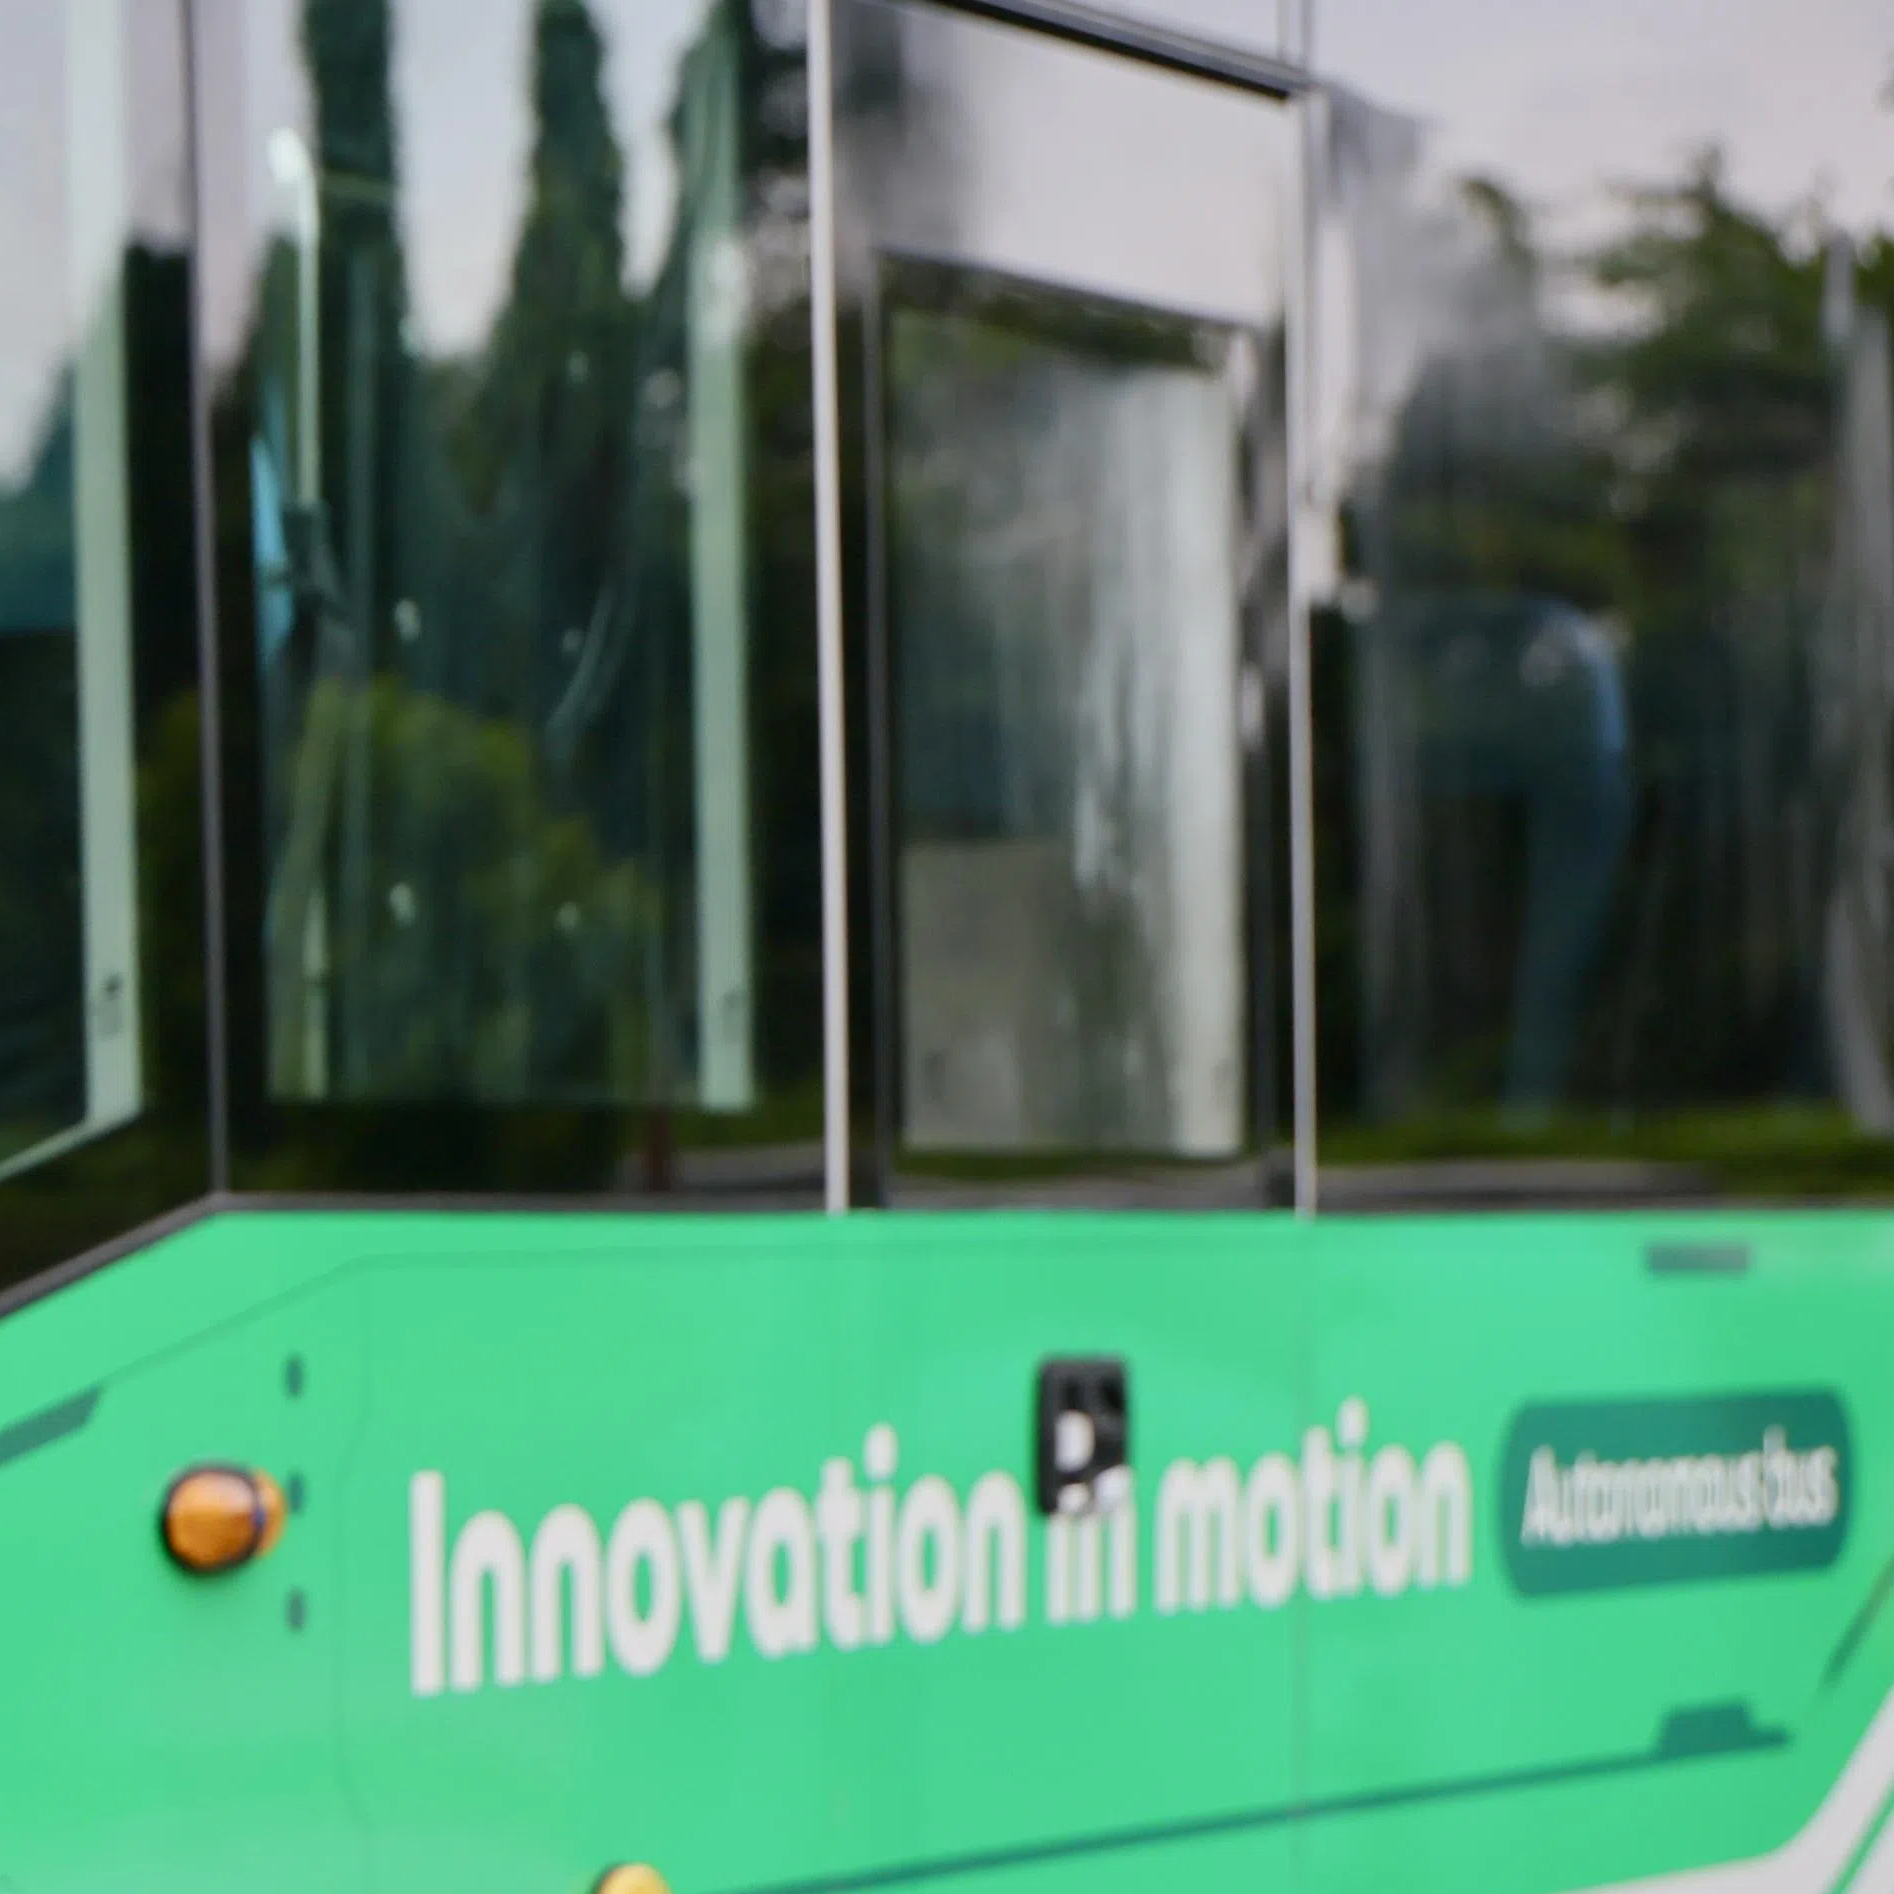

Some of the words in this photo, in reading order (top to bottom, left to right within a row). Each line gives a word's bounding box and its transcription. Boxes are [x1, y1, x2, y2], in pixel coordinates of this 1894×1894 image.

[410, 1422, 1025, 1696] Innovation
[1154, 1396, 1473, 1614] motion
[1519, 1443, 1762, 1551] Autonomous
[1763, 1422, 1841, 1530] bus
